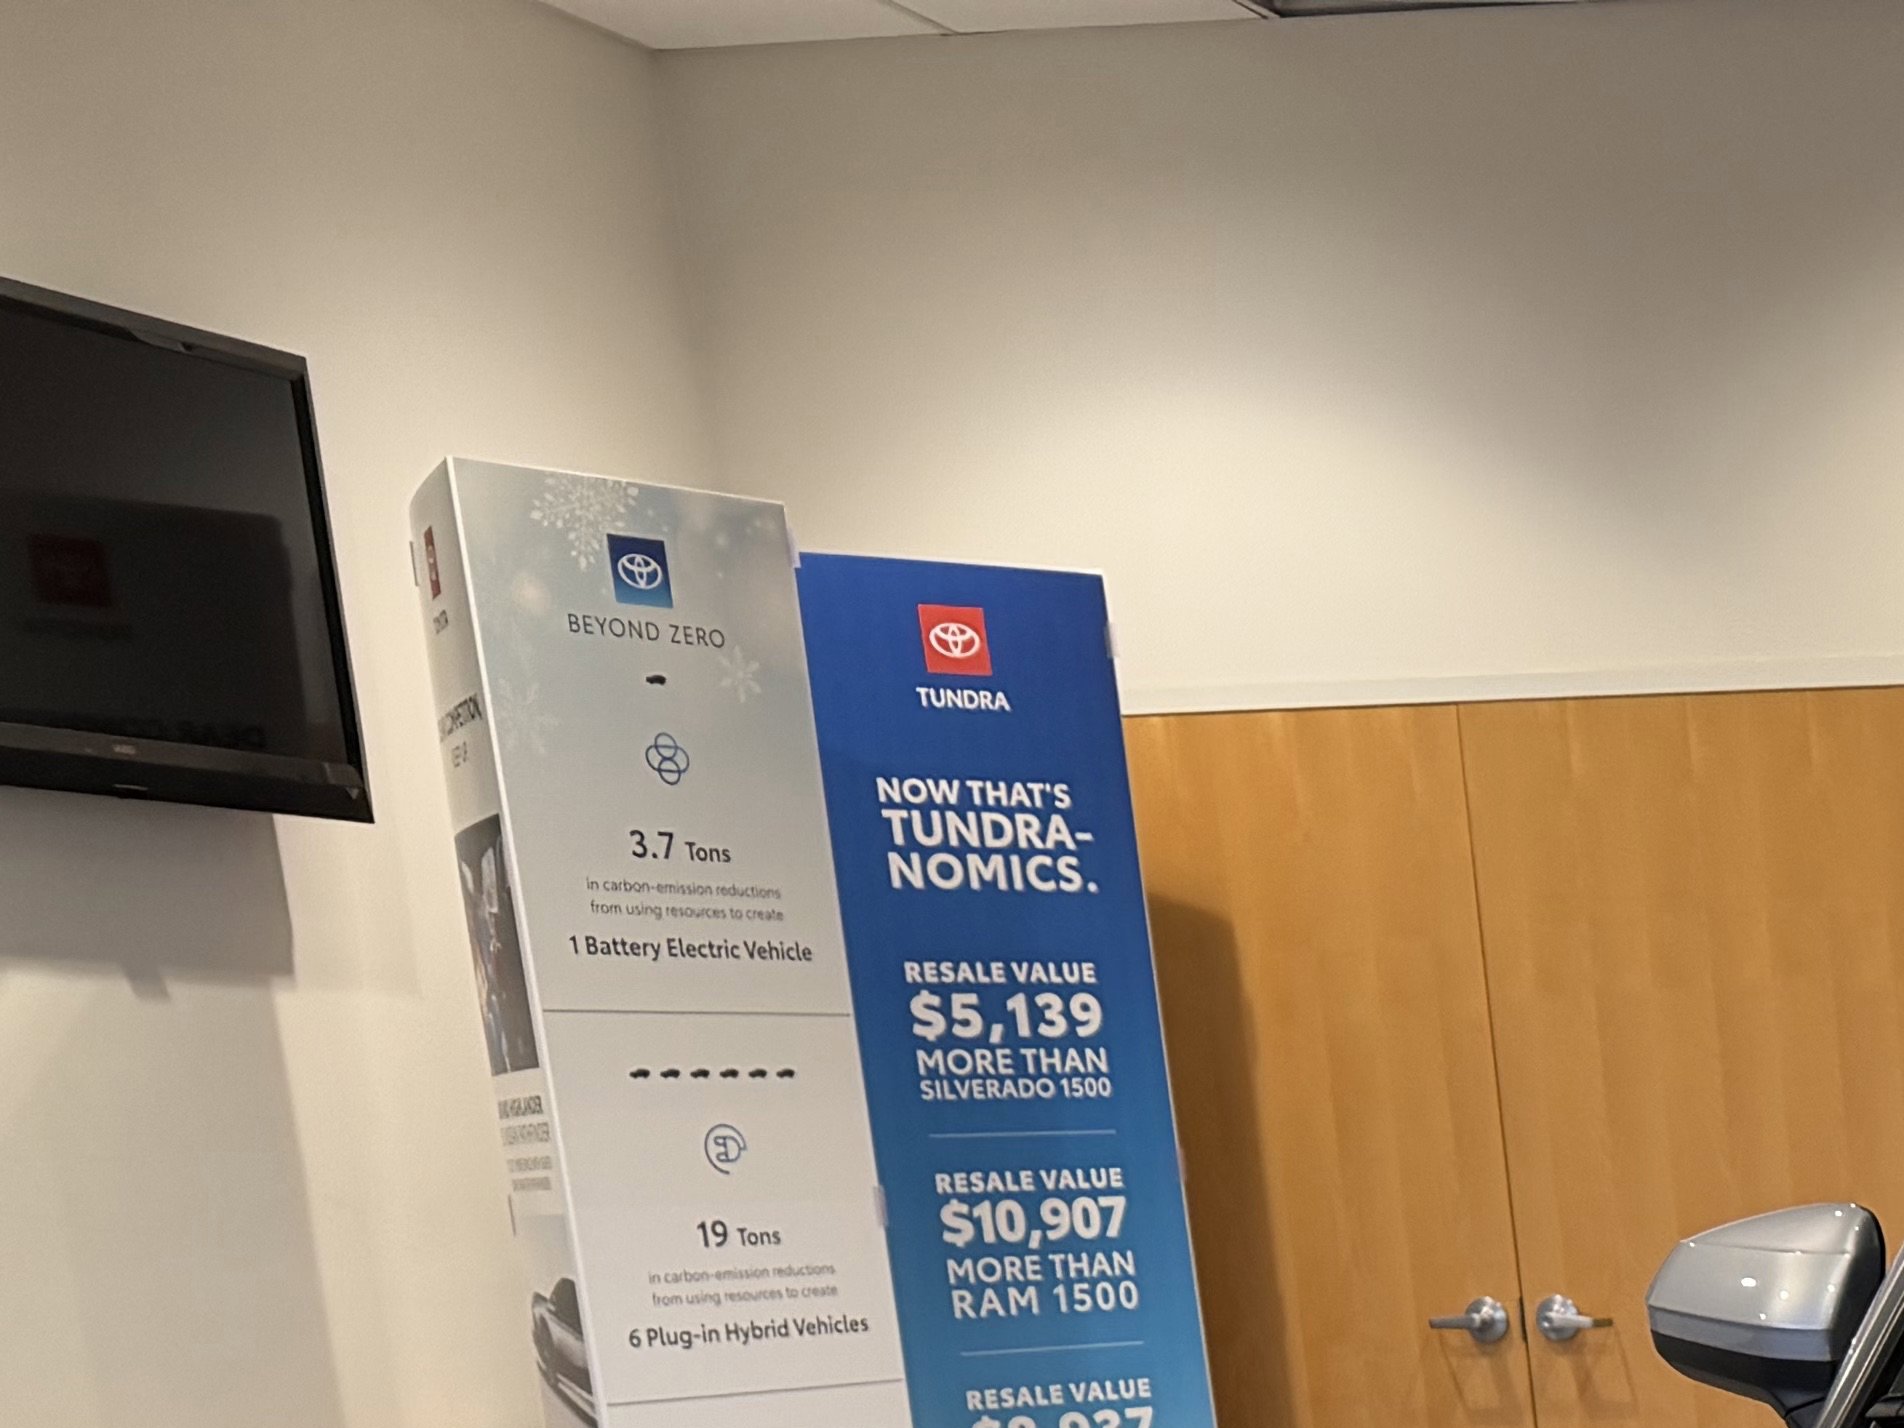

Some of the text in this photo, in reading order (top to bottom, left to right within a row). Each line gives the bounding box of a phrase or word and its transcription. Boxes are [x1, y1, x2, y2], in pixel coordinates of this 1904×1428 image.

[567, 613, 725, 649] BEYOND ZERO
[915, 686, 1012, 712] TUNDRA
[876, 776, 1073, 810] NOW THAT'S
[881, 808, 1094, 851] TUNDRA-
[629, 829, 732, 863] 3.7 Tons
[586, 877, 781, 899] in carbon-emission reductions
[887, 852, 1099, 894] NOMICS.
[590, 899, 784, 921] from using resources to create
[569, 935, 813, 962] 1 Battery Electric Vehicle
[903, 961, 1097, 984] RESALE VALUE
[909, 989, 1104, 1044] $5,139
[916, 1047, 1110, 1076] MORE THAN
[919, 1077, 1112, 1101] SILVERADO 1500
[934, 1167, 1125, 1194] RESALE VALUE
[696, 1219, 782, 1248] 19 Tons
[939, 1195, 1126, 1249] $10,907
[648, 1263, 836, 1284] in carbon-emission reductions
[945, 1250, 1137, 1284] MORE THAN
[652, 1284, 838, 1307] from using resources to create
[951, 1280, 1140, 1320] RAM 1500
[628, 1314, 870, 1350] 6 Plug-in Hybrid Vehicles
[965, 1377, 1152, 1411] RESALE VALUE
